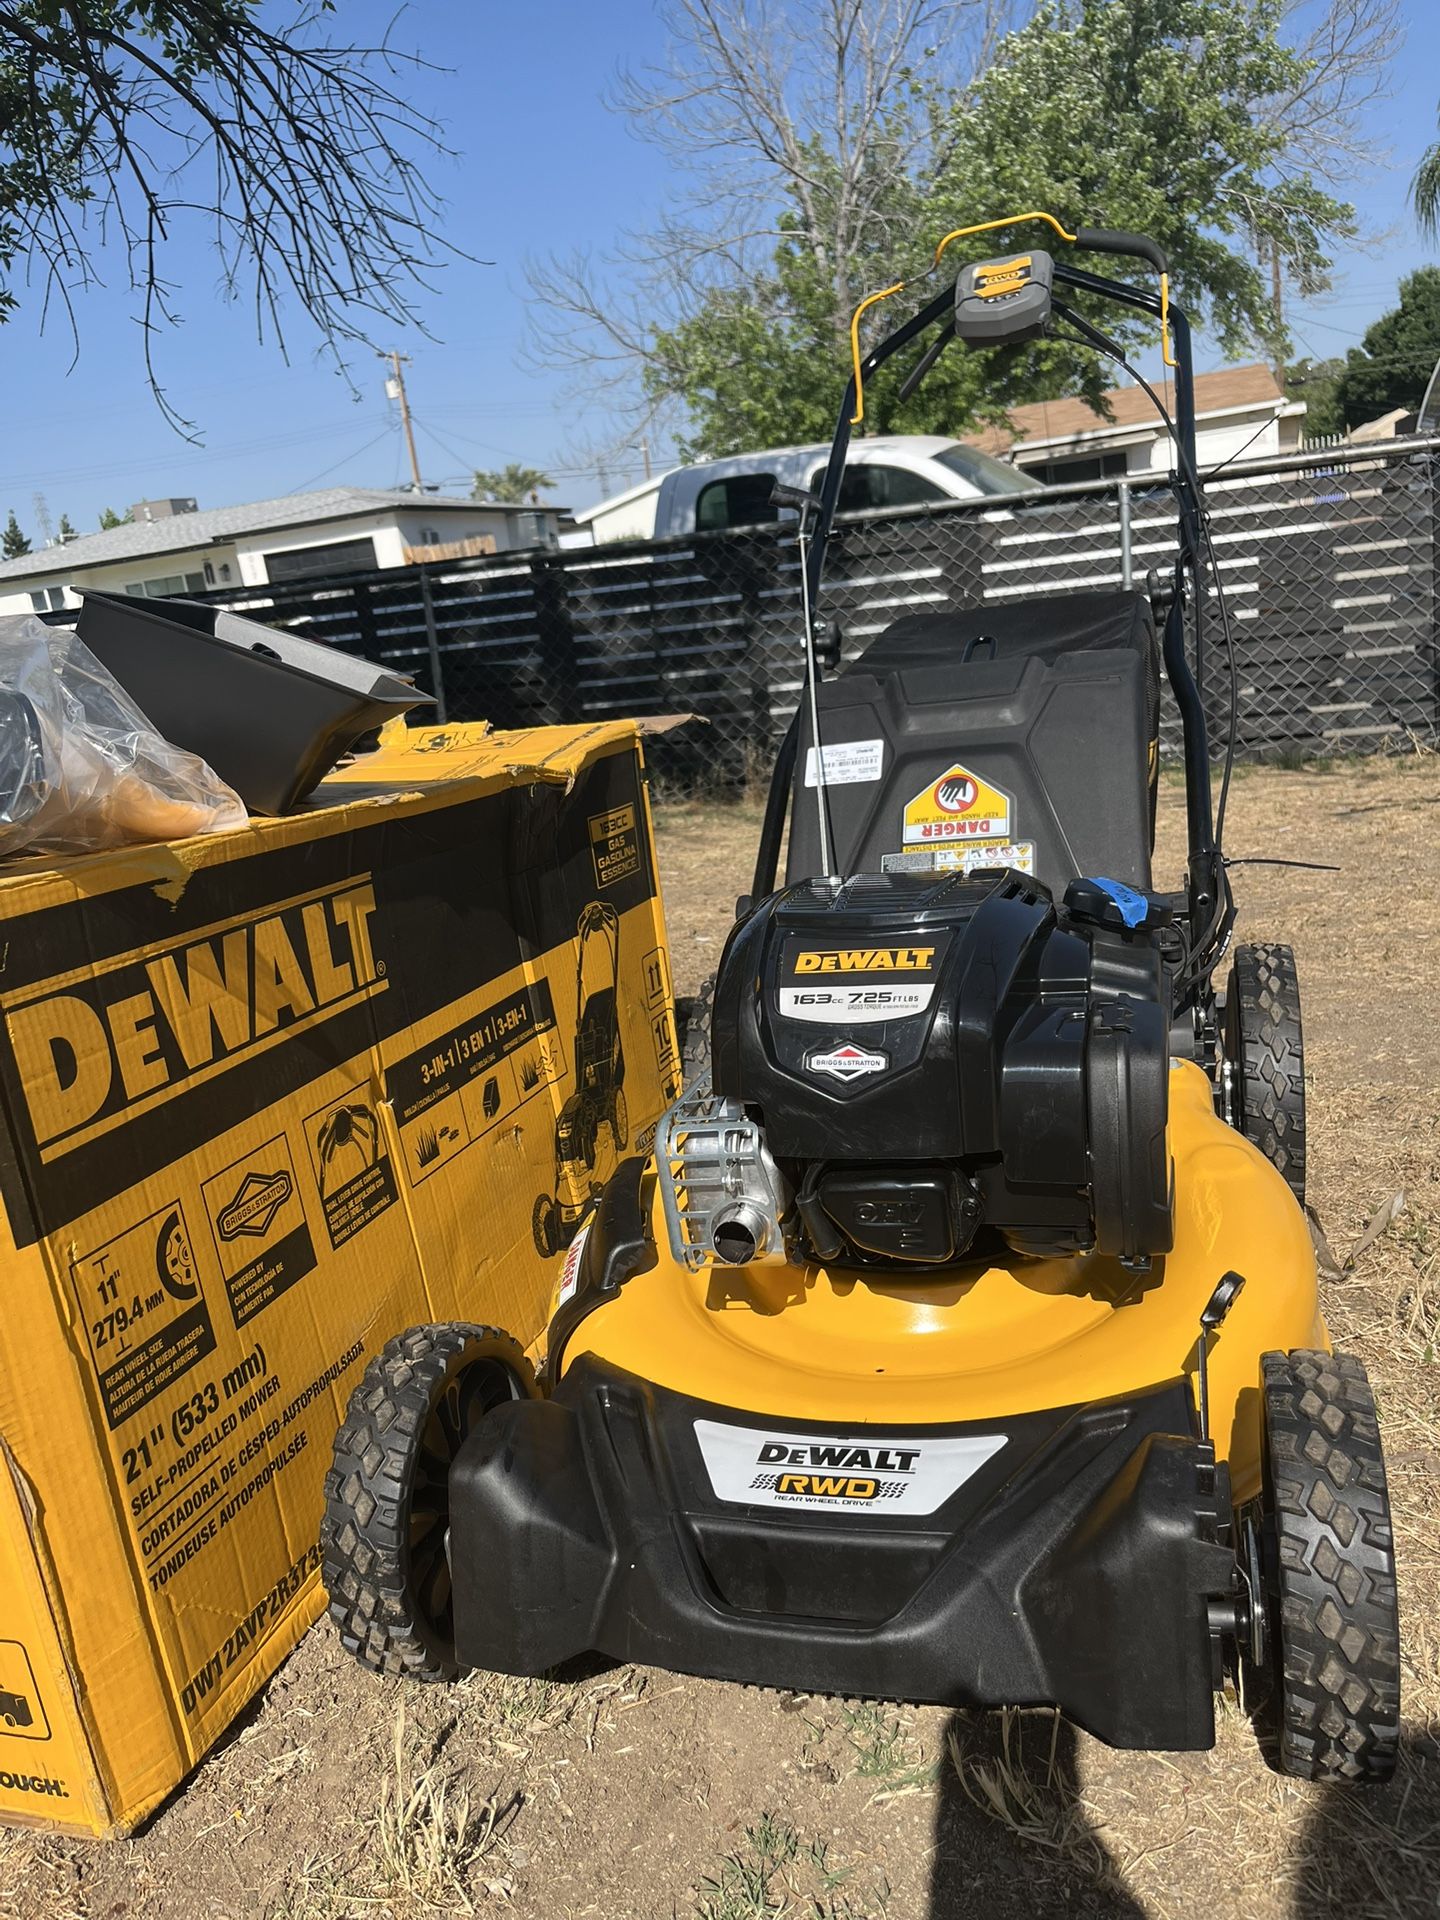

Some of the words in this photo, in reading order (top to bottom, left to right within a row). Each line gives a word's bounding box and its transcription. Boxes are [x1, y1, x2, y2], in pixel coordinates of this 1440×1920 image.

[600, 814, 628, 834] 163CC
[608, 835, 625, 851] GAS
[922, 820, 990, 837] DANGER
[598, 844, 636, 869] GASOLINA
[601, 857, 637, 882] ESSENCE
[795, 949, 935, 973] DEWALT
[5, 883, 376, 1145] DEWALT
[848, 991, 892, 1004] 7.25
[421, 1048, 456, 1085] 3-IN-1
[462, 1039, 470, 1059] 3
[471, 1031, 485, 1054] EN
[497, 1003, 528, 1035] 3-EN-1
[225, 1182, 286, 1230] BRIGGS&STRATTON
[231, 1268, 257, 1294] POWERED
[255, 1261, 265, 1275] BY
[234, 1293, 247, 1307] CON
[274, 1262, 284, 1275] DE
[561, 1241, 583, 1290] DANGER
[97, 1269, 121, 1306] 11"
[238, 1290, 264, 1320] ALIMENTÉ
[263, 1284, 275, 1300] PAR
[92, 1295, 145, 1349] 279.4
[145, 1288, 165, 1313] MM
[105, 1368, 126, 1389] REAR
[125, 1352, 150, 1375] WHEEL
[148, 1337, 164, 1357] SIZE
[109, 1378, 136, 1405] ALTURA
[136, 1370, 147, 1386] DE
[146, 1362, 157, 1377] LA
[157, 1347, 178, 1370] RUEDA
[176, 1324, 205, 1355] TRASERA
[112, 1390, 145, 1419] HAUTEUR
[144, 1380, 155, 1396] DE
[154, 1368, 173, 1390] ROUE
[172, 1343, 200, 1375] ARRIÈRE
[122, 1424, 165, 1486] 21"
[171, 1381, 220, 1448] (533
[222, 1343, 268, 1400] mm)
[131, 1415, 238, 1517] SELF-PROPELLED
[240, 1375, 281, 1423] MOWER
[141, 1476, 219, 1556] CORTADORA
[222, 1458, 238, 1486] DE
[239, 1419, 280, 1467] CÉSPED
[283, 1341, 366, 1426] AUTOPROPULSADA
[756, 1442, 920, 1471] DEWALT
[778, 1474, 876, 1497] RWD
[805, 1497, 840, 1505] WHEEL
[841, 1499, 873, 1507] DRIVE
[149, 1521, 218, 1592] TONDEUSE
[220, 1430, 309, 1529] AUTOPROPULSÉE
